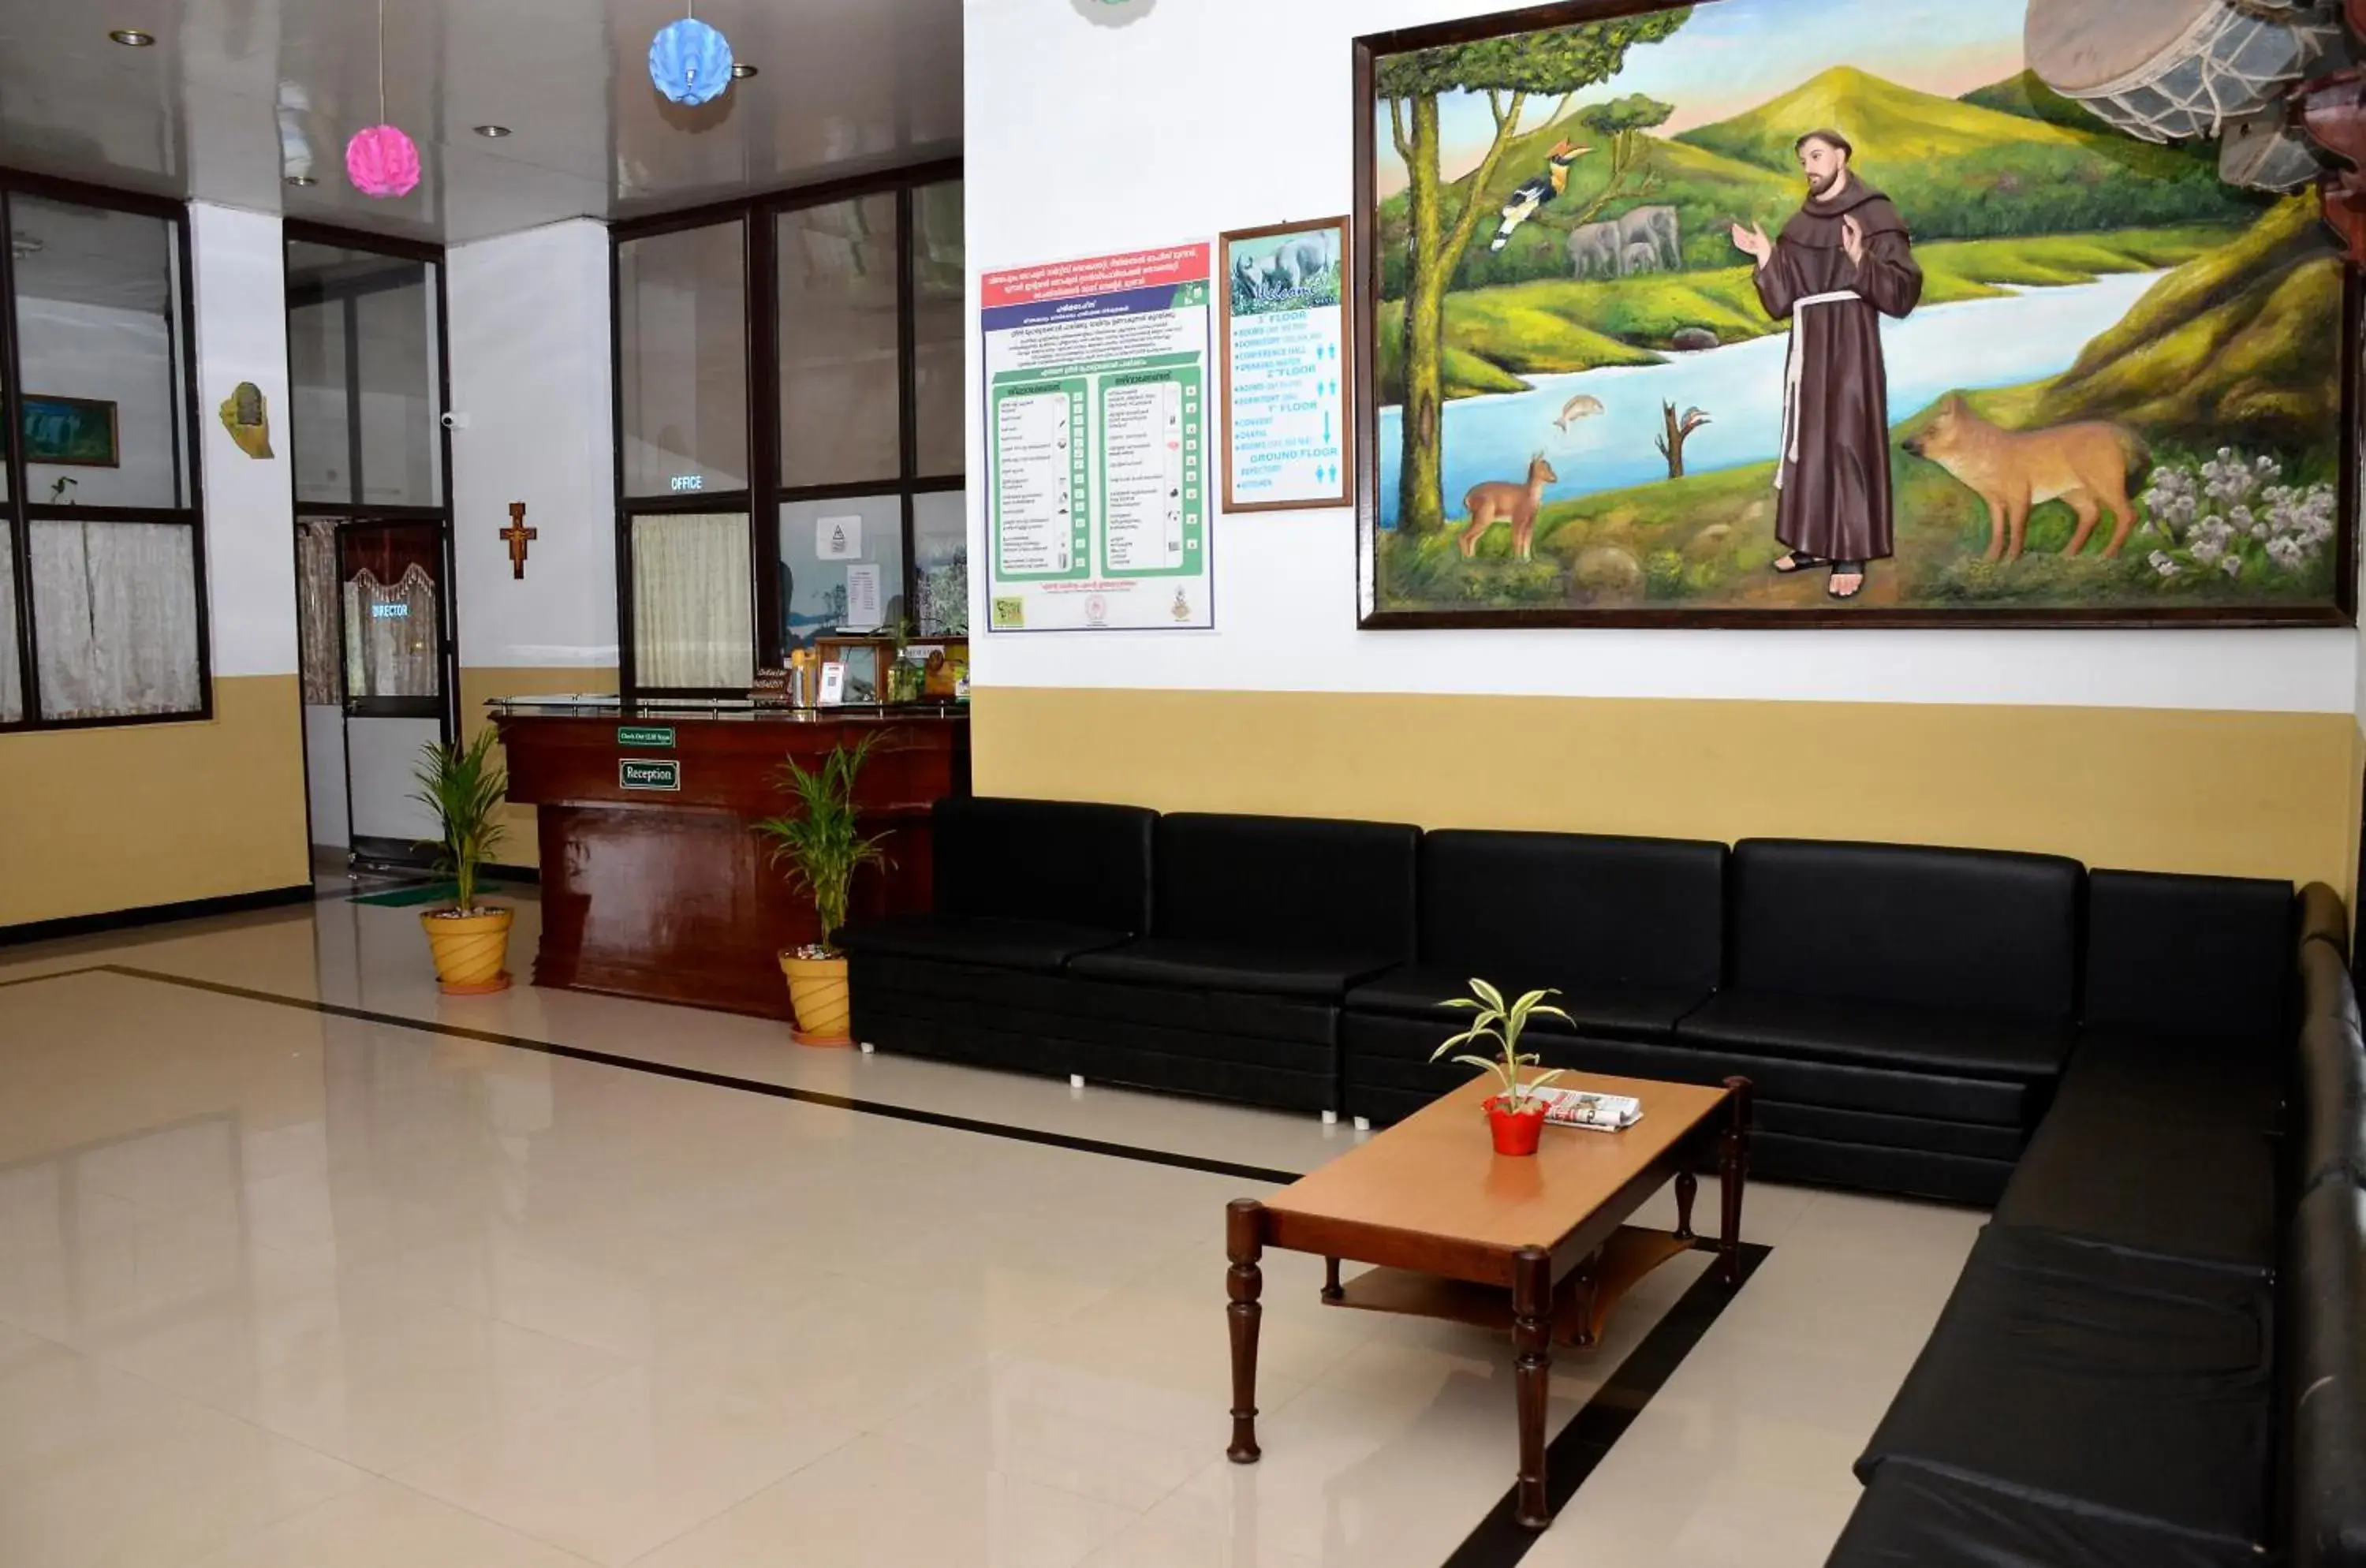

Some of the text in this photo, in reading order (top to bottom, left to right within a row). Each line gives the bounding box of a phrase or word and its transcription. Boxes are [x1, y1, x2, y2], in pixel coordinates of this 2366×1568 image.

[1250, 446, 1338, 463] GROUND FLOOR
[671, 476, 702, 490] OFFICE
[371, 604, 408, 618] DIRECTOR
[627, 766, 672, 783] Reception
